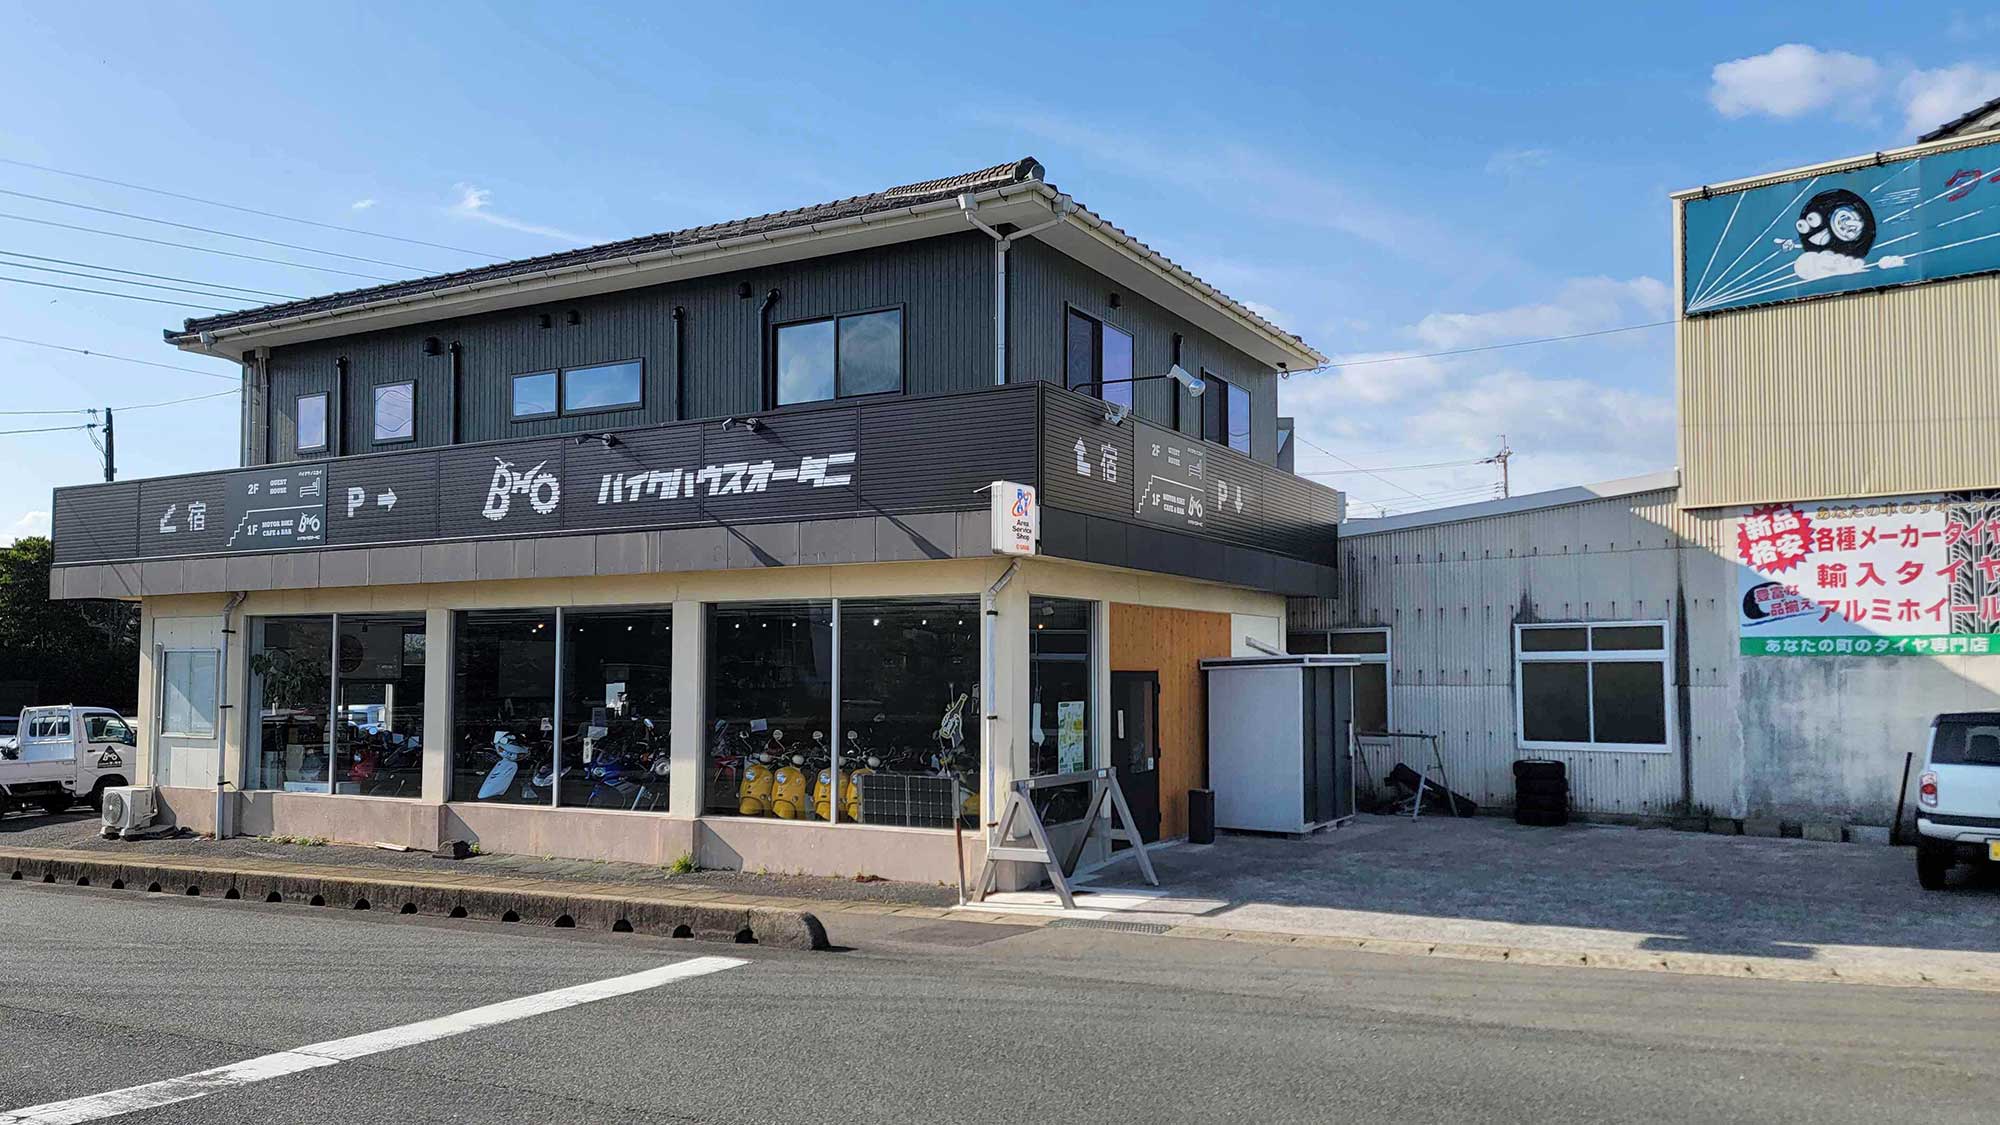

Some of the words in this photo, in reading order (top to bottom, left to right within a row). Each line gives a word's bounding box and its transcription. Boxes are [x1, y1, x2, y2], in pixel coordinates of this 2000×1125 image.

[1152, 443, 1160, 456] 2F
[1100, 442, 1118, 483] 宿
[597, 452, 856, 504] バイクハウスオータニ
[247, 483, 259, 495] 2F
[1217, 479, 1228, 511] P
[347, 487, 365, 518] P
[1152, 493, 1160, 506] 1F
[187, 500, 206, 532] 宿
[1016, 519, 1029, 527] Area
[1745, 508, 1800, 541] 新品
[247, 524, 258, 536] 1F
[1012, 525, 1032, 533] Service
[1016, 532, 1030, 541] Shop
[1750, 533, 1806, 565] 格安
[1817, 555, 2000, 589] 輸入タイヤ
[1754, 584, 1799, 602] 豊富な
[1770, 598, 1815, 617] 品揃え
[1817, 596, 2000, 624] アルミホイール
[1765, 637, 1990, 654] あなたの町のタイヤ専門店
